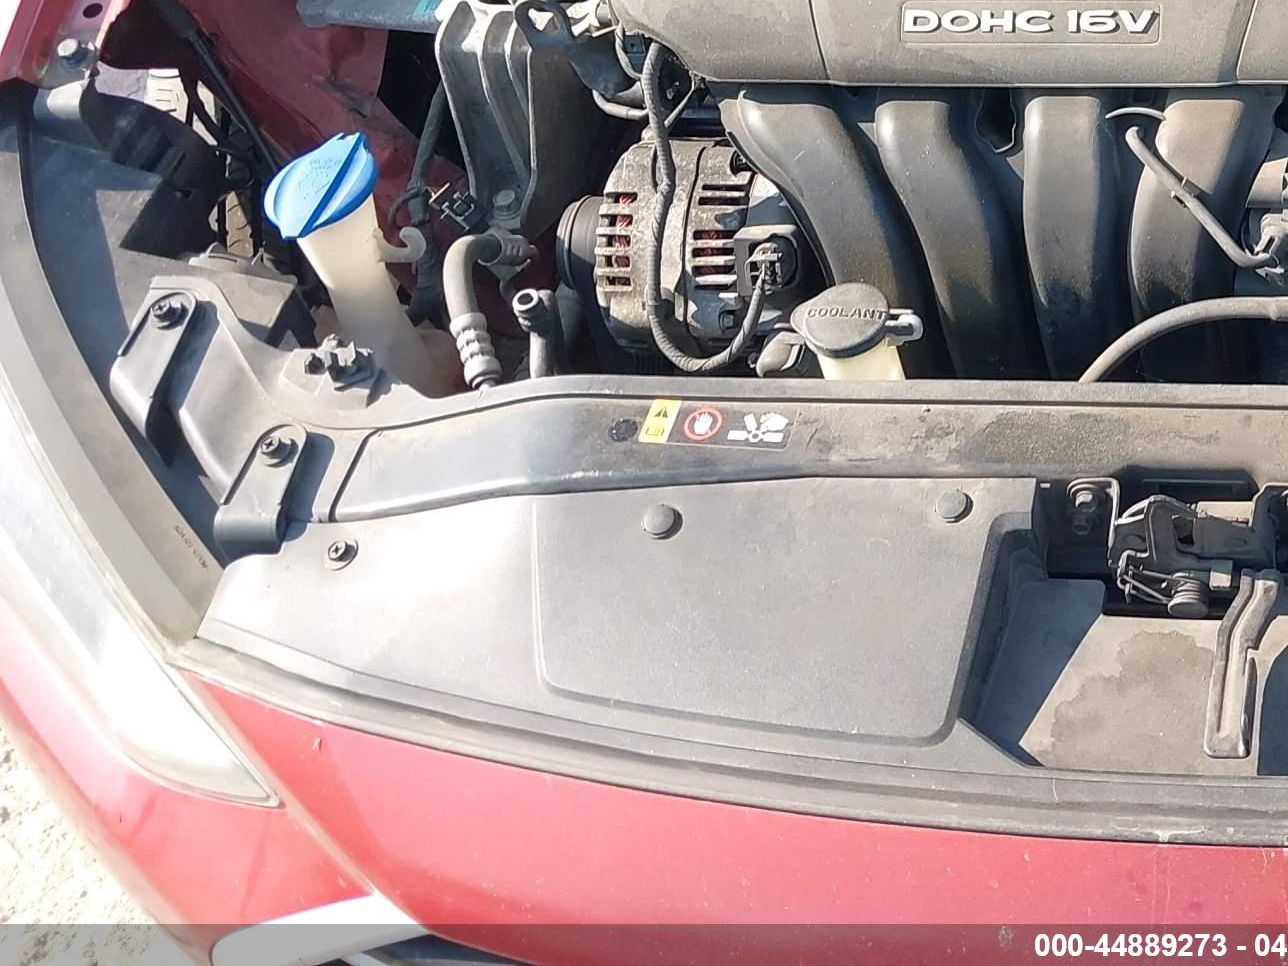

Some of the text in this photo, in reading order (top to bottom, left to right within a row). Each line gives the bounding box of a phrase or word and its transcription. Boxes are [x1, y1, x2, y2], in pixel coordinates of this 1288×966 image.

[903, 8, 1160, 34] DOHC 16V
[808, 307, 885, 320] COOLANT
